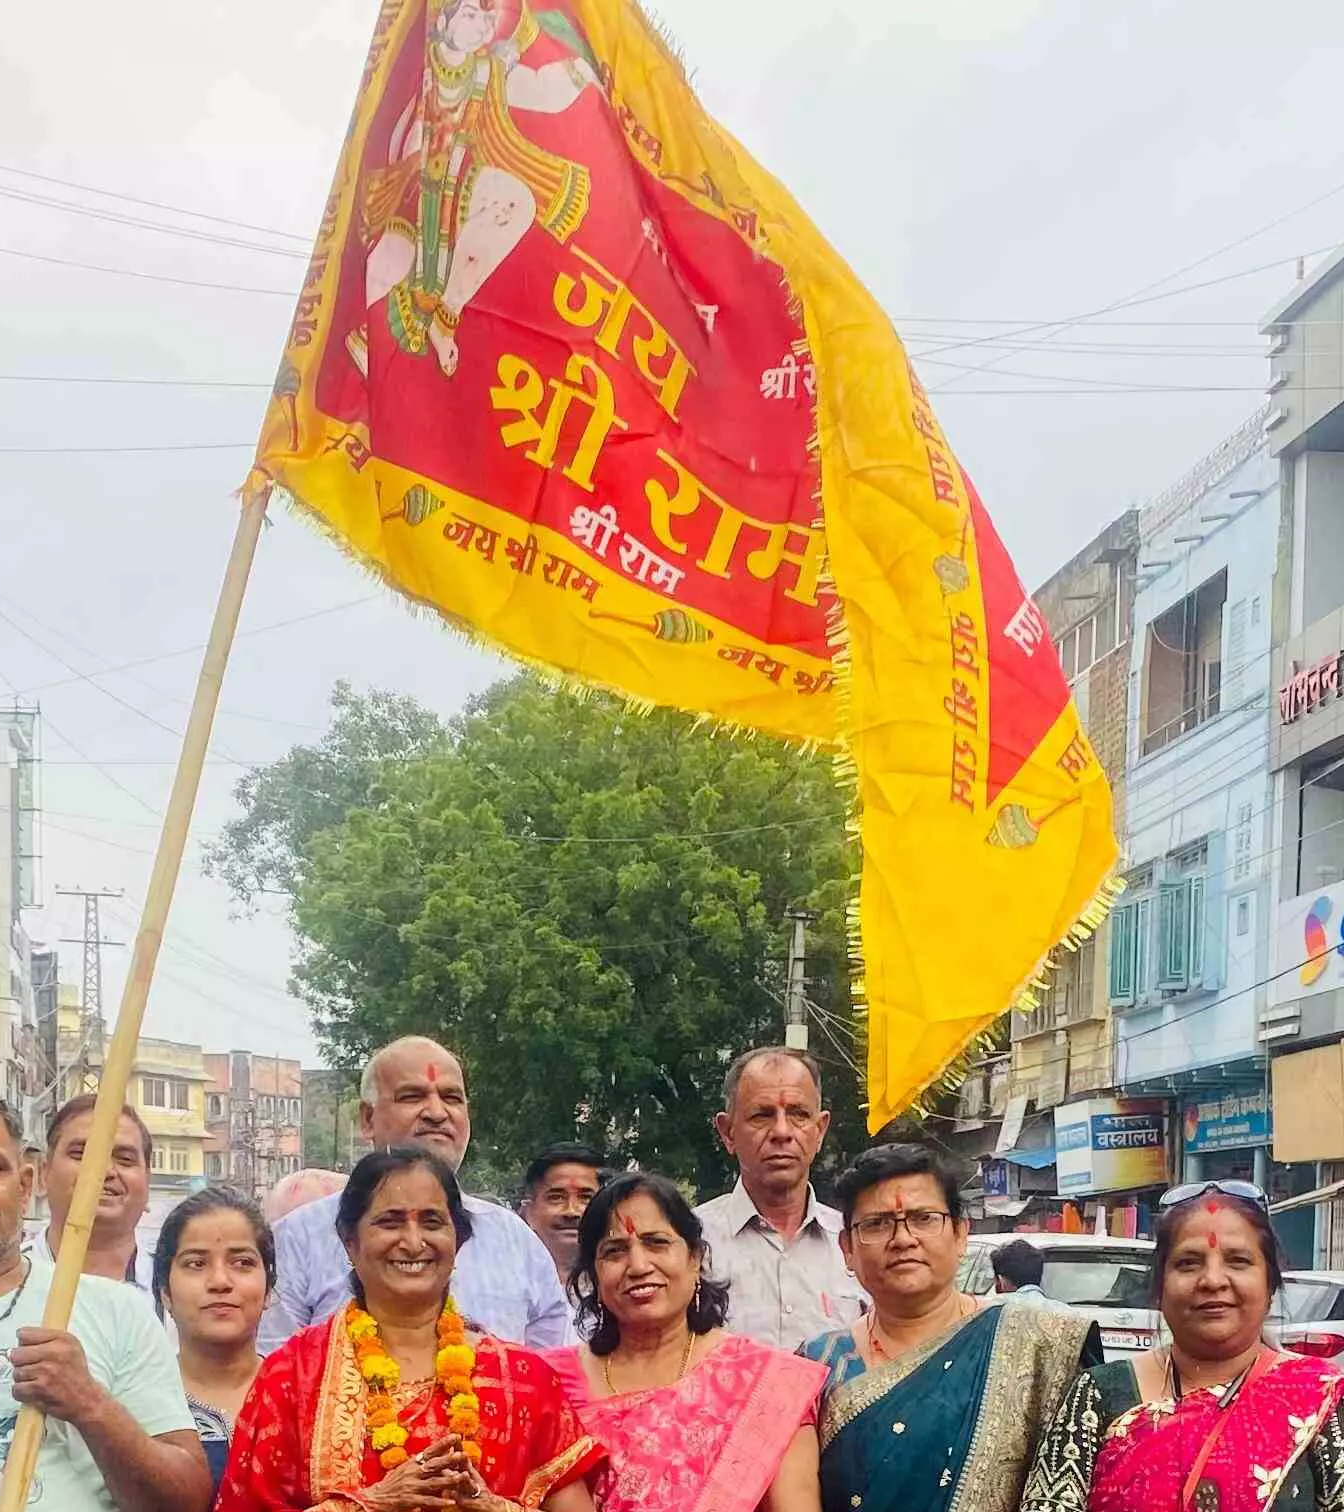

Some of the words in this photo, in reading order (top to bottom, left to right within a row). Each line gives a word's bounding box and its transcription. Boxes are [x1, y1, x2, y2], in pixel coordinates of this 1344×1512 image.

[553, 244, 699, 422] जय
[489, 353, 629, 493] श्री
[644, 447, 828, 608] राम
[443, 511, 501, 564] जय
[504, 533, 540, 576] श्री
[542, 551, 605, 603] राम
[569, 504, 621, 558] श्री
[620, 531, 687, 596] राम
[717, 645, 793, 684] जय
